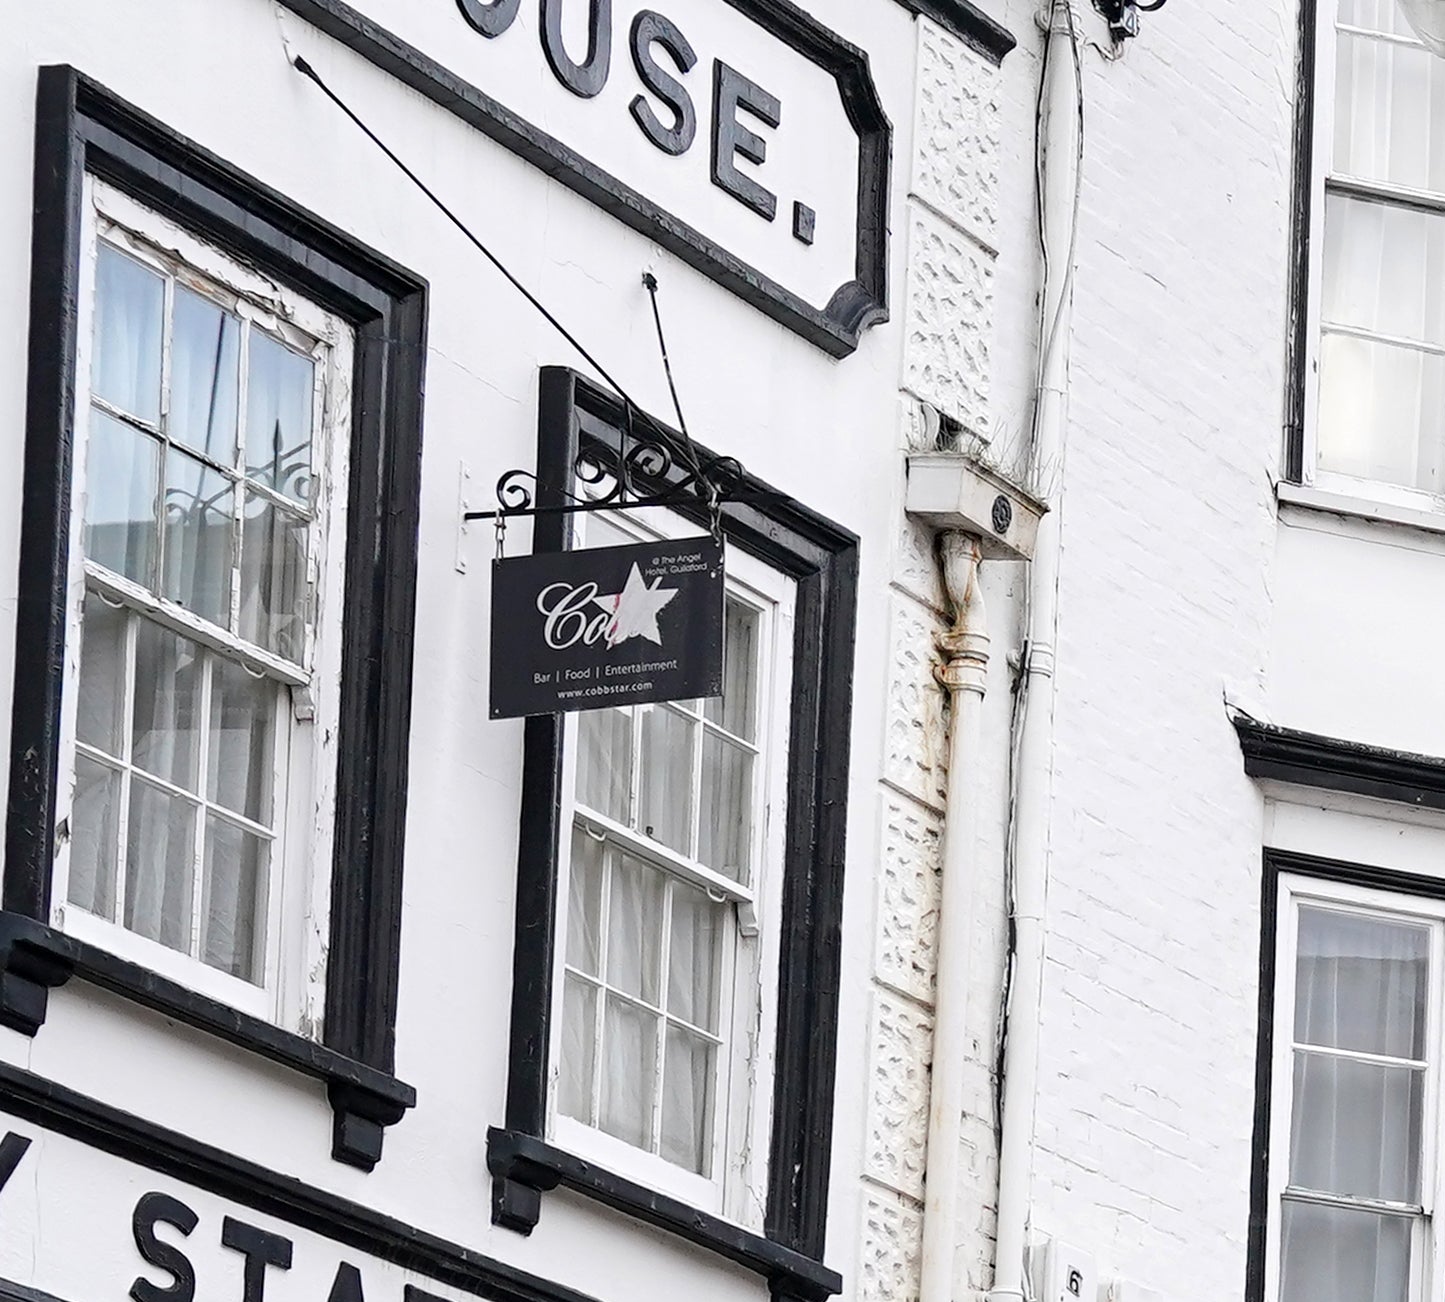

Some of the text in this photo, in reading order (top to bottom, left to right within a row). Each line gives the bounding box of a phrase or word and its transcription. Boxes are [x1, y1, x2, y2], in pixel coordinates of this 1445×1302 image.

[455, 0, 815, 246] USE.
[534, 659, 679, 684] Bar Food Entertainment
[557, 681, 653, 699] www.cobbstar.com
